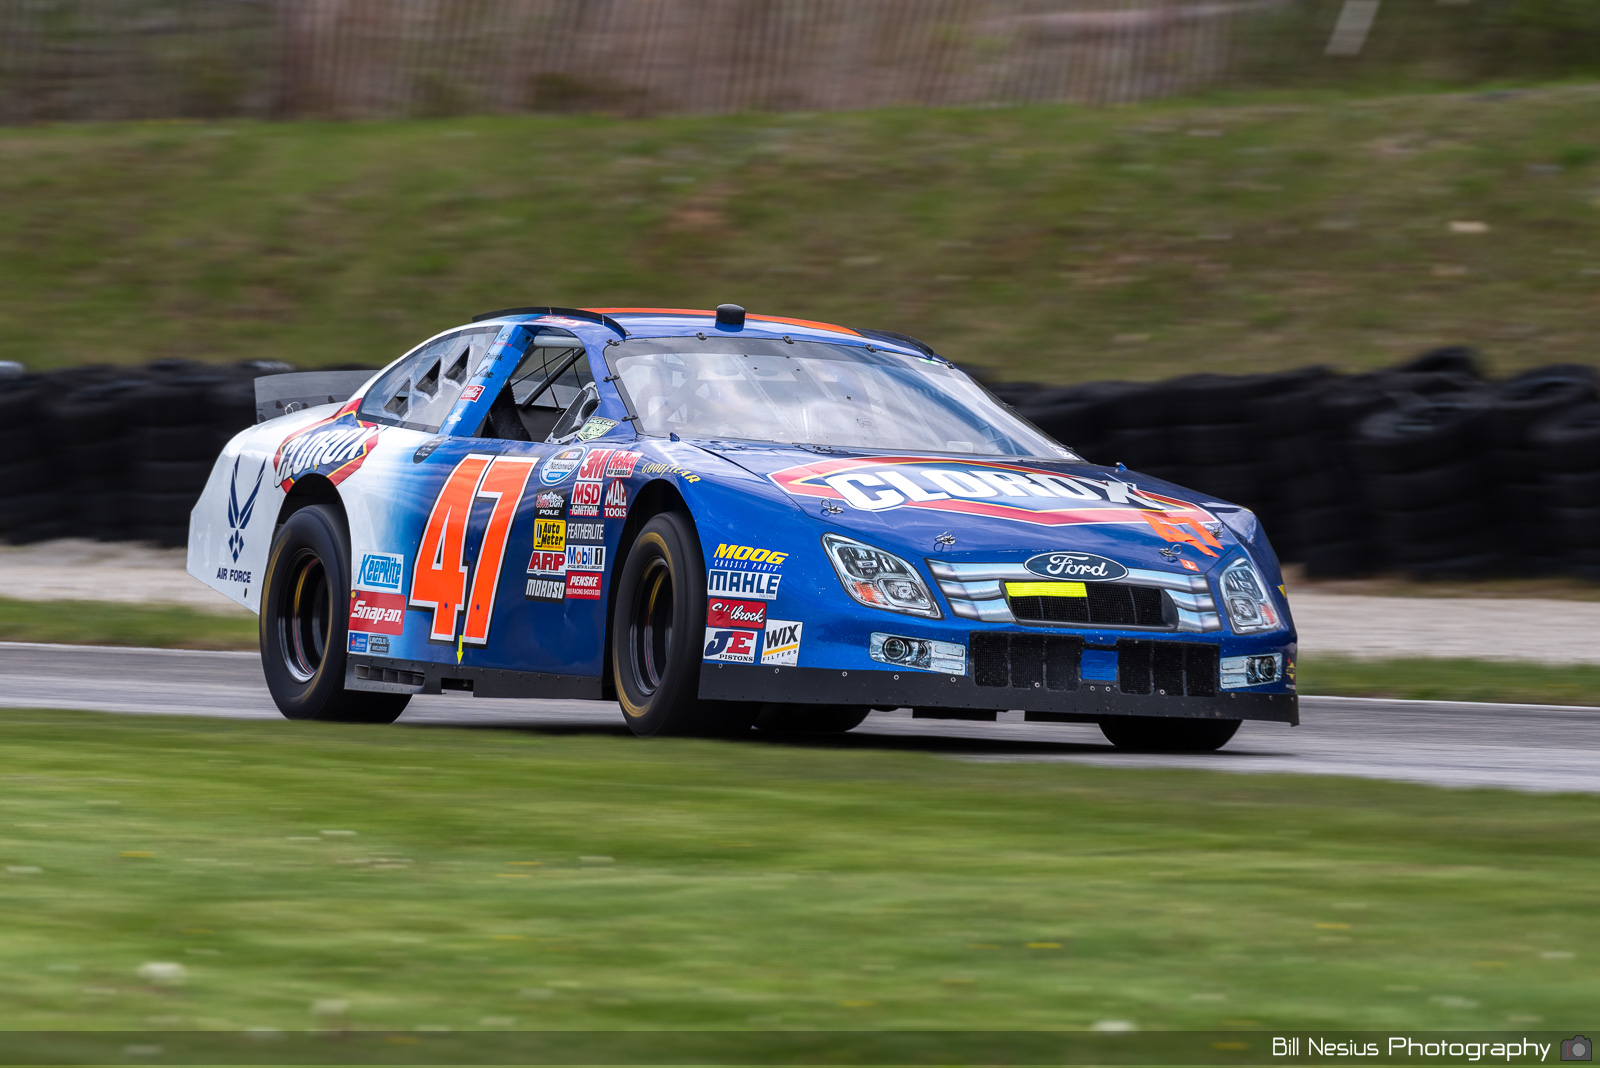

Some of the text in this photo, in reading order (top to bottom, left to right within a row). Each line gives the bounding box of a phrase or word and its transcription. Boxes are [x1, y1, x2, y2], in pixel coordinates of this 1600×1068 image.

[274, 425, 381, 488] CLOROX
[549, 461, 575, 471] Nationwide
[580, 450, 614, 478] 3M
[608, 451, 639, 475] Holley
[641, 462, 701, 484] GOODYEAR
[572, 483, 601, 505] MSD
[604, 480, 627, 506] MAC
[824, 468, 1165, 512] CLOROX
[571, 504, 598, 516] IGNITION
[605, 507, 626, 517] TOOLS
[543, 522, 560, 534] Auto
[567, 523, 604, 540] FEATHERLITE
[409, 453, 540, 645] 47
[541, 533, 564, 546] Meter
[528, 552, 566, 571] ARP
[567, 546, 593, 566] Mobil
[713, 543, 789, 565] MOOG
[216, 567, 252, 583] AIR FORCE
[357, 554, 402, 589] KeepRite
[714, 559, 779, 572] CHASSIS PARTS
[1046, 554, 1109, 577] Ford
[525, 578, 566, 599] MOROSO
[570, 575, 599, 588] PENSKE
[709, 570, 780, 595] MAHLE
[351, 600, 402, 625] Snap-on
[704, 630, 755, 658] JE
[765, 624, 799, 650] WIX
[719, 653, 754, 663] PISTONS
[762, 650, 797, 662] FILTERS
